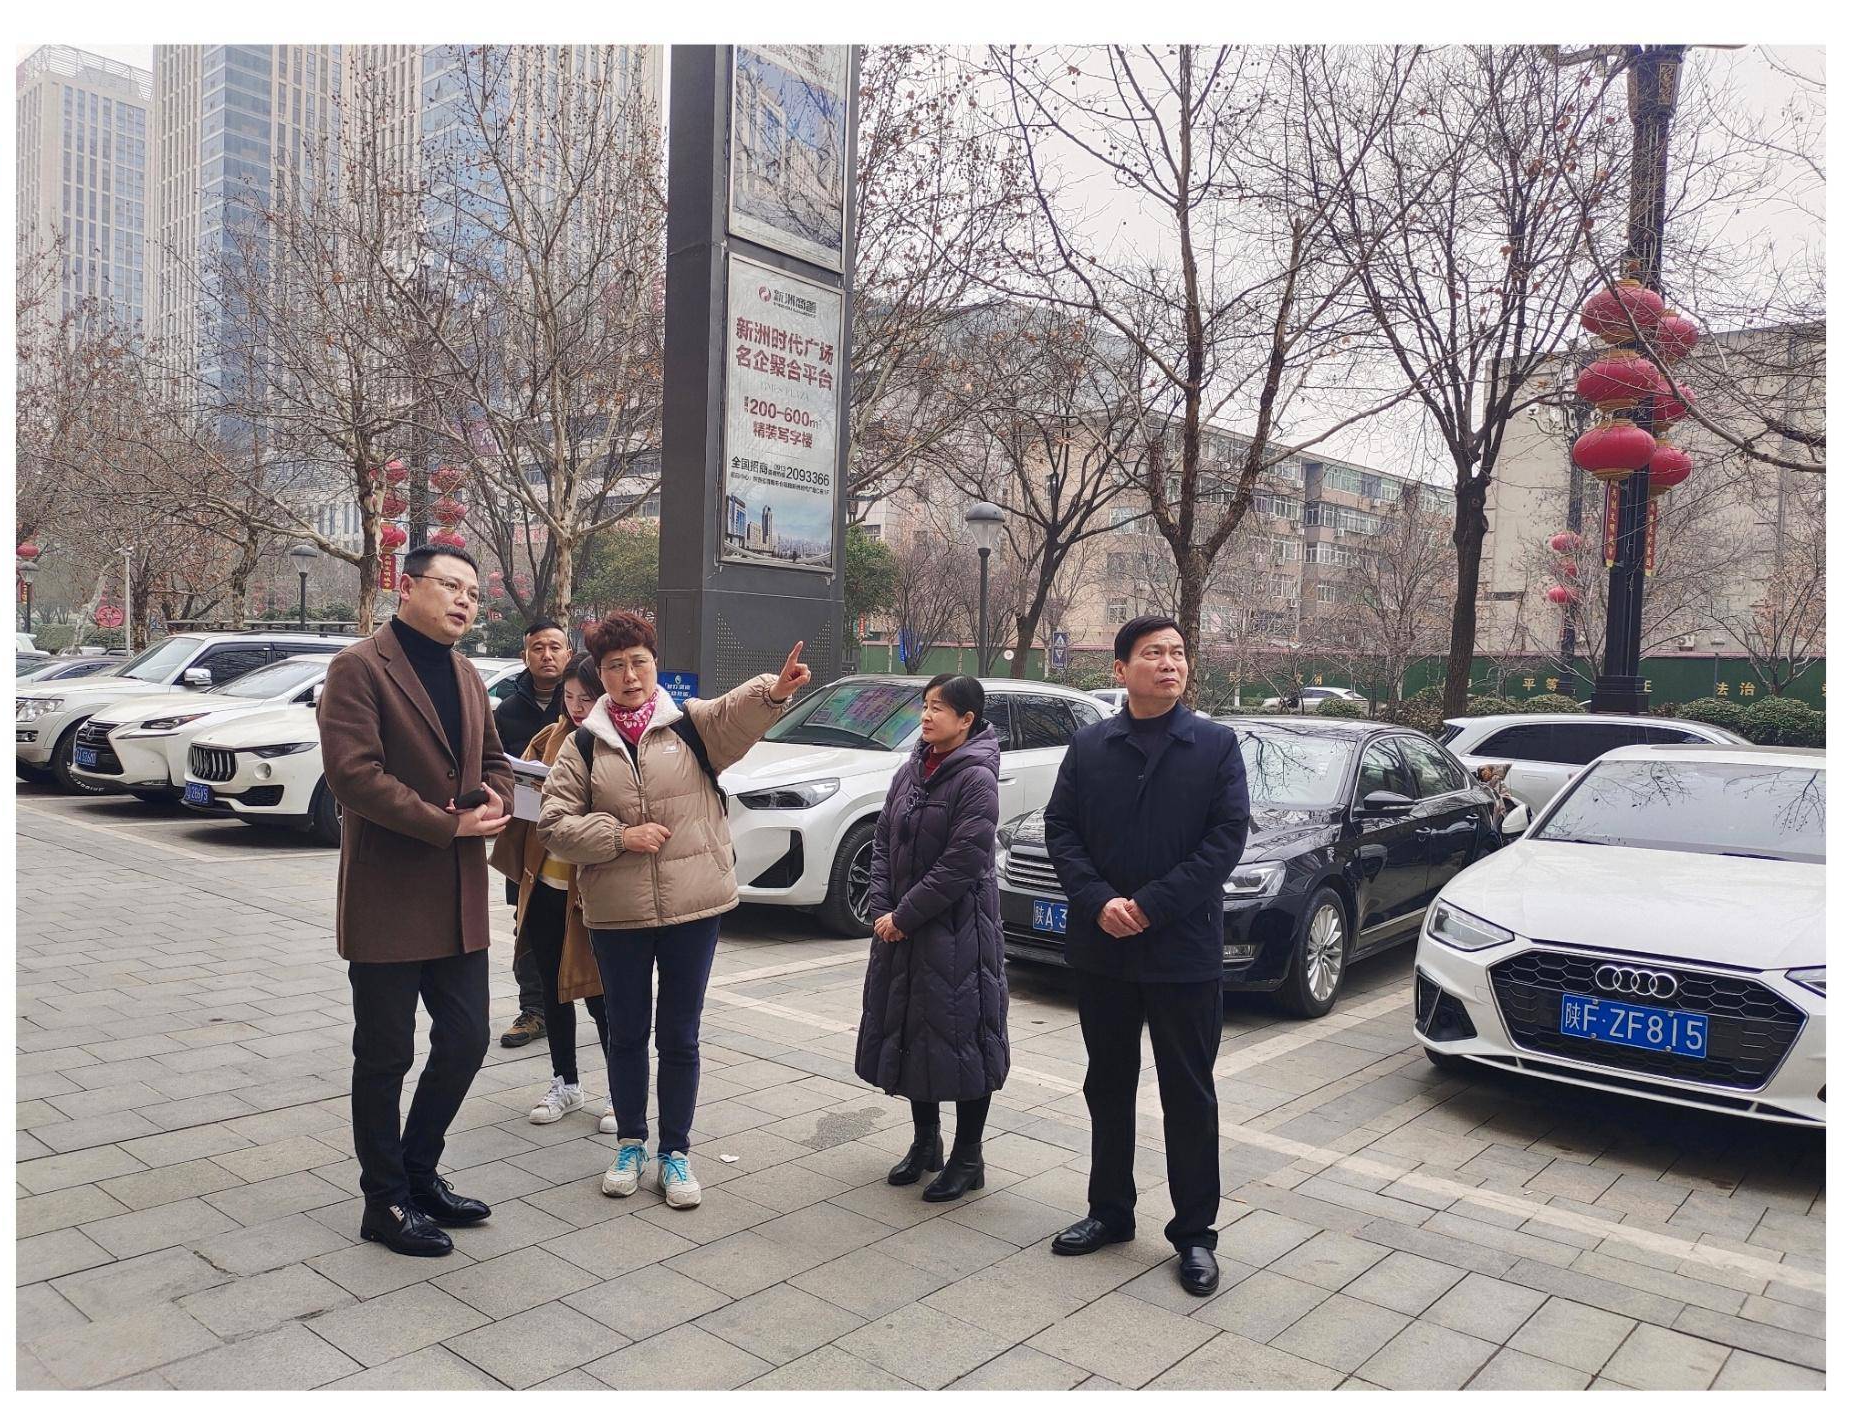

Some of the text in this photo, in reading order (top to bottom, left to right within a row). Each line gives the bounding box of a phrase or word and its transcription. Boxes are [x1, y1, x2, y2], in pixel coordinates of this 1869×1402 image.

[736, 316, 834, 366] 新洲时代广场
[736, 344, 834, 391] 名企聚合平台
[753, 421, 813, 449] 精装写字楼
[731, 456, 768, 475] 全国招商
[786, 466, 830, 487] 2093366
[1716, 681, 1757, 697] 法治
